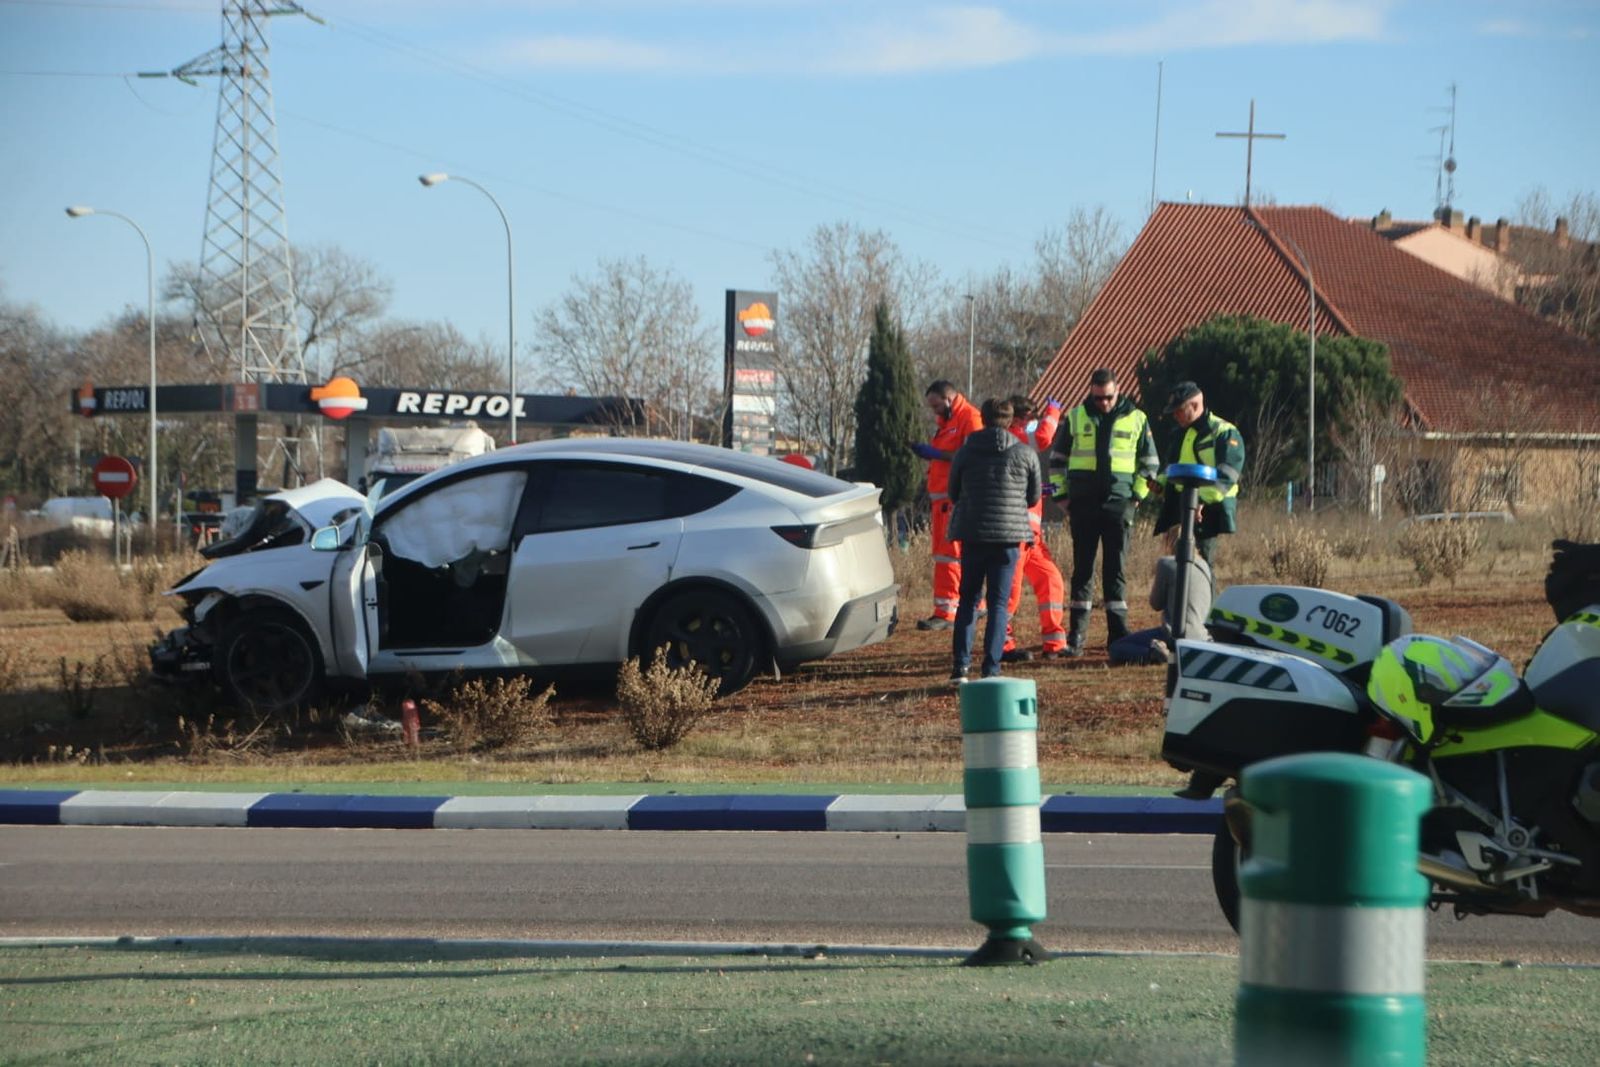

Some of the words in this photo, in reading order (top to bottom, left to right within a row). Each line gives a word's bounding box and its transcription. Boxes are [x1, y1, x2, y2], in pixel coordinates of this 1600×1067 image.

[104, 390, 145, 409] REPSOL
[397, 392, 526, 417] REPSOL
[1322, 609, 1361, 638] 062
